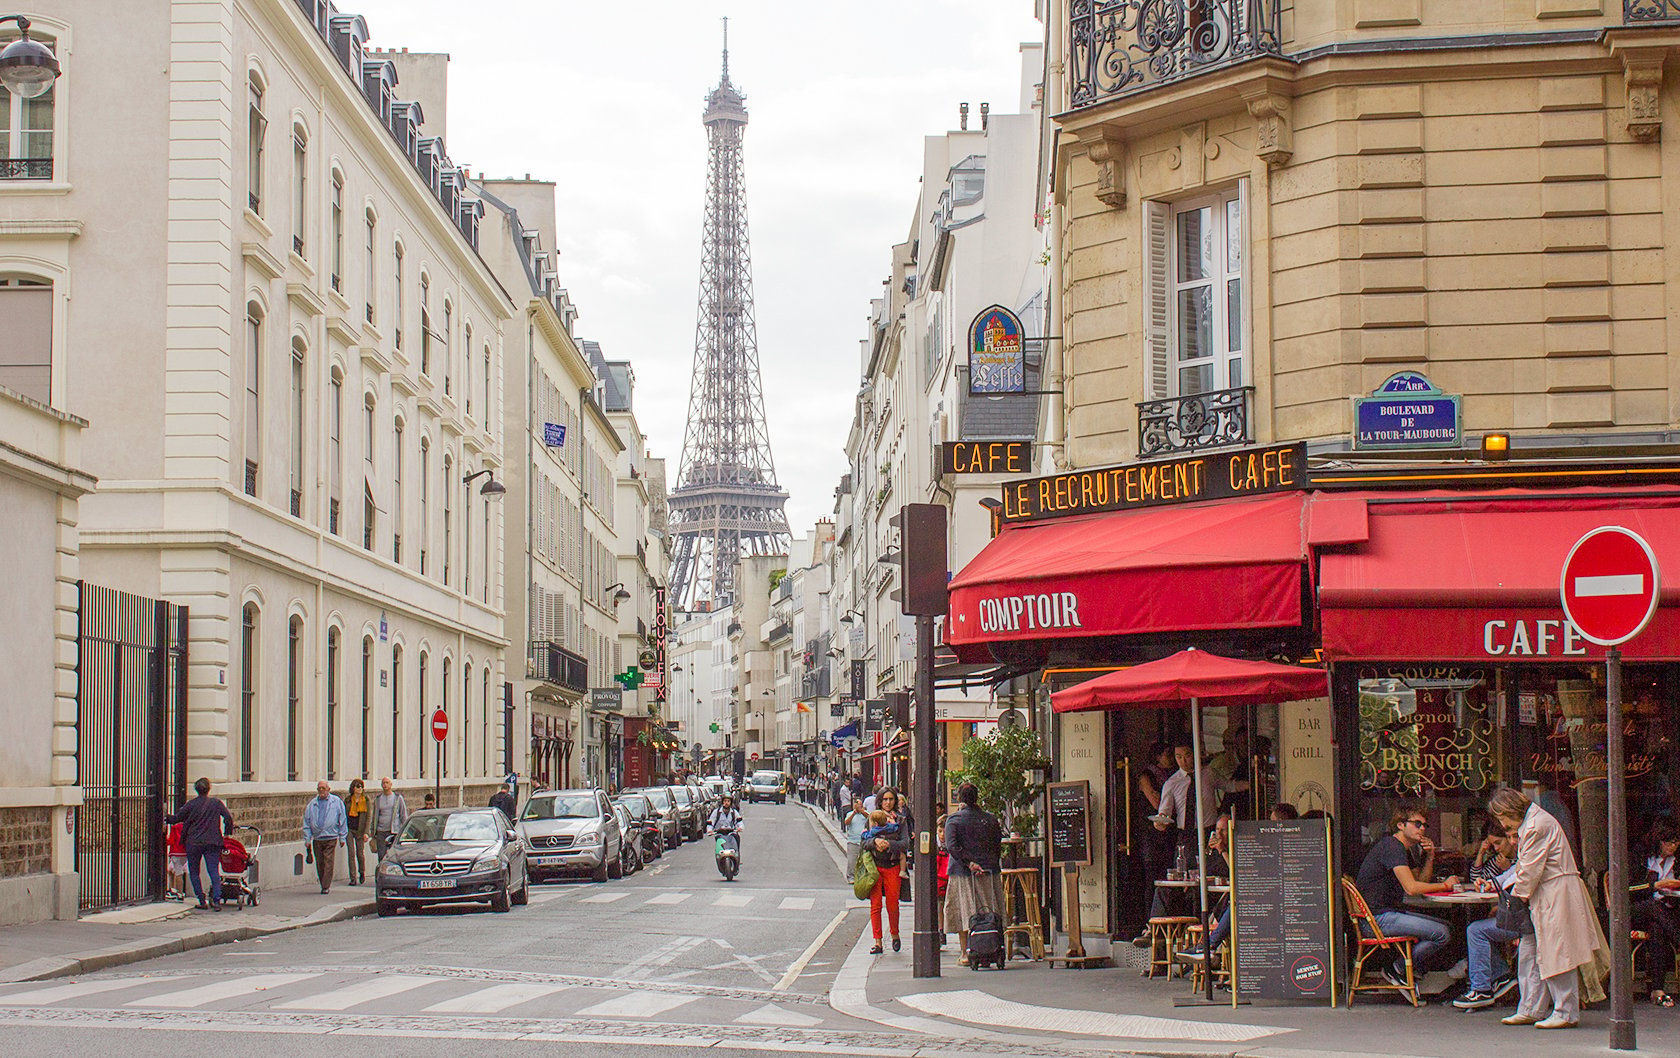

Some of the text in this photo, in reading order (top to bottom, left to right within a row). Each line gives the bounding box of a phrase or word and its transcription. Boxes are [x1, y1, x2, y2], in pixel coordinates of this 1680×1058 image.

[972, 365, 1023, 389] Leffe
[1379, 404, 1435, 416] BOULEVARD
[1400, 417, 1415, 428] DE
[1360, 428, 1456, 441] LA TOUR-MAUBOURG
[952, 442, 1022, 473] CAFE
[1004, 447, 1295, 520] LE RECRUTEMENT CAFE
[979, 592, 1082, 632] COMPTOIR
[656, 589, 666, 699] THOUMIEUX
[1484, 619, 1587, 656] CAFE
[1074, 723, 1090, 733] BAR
[1298, 718, 1321, 730] BAR
[1071, 749, 1093, 758] GRILL
[1292, 747, 1323, 759] GRILL
[1381, 748, 1474, 771] BRUNCH
